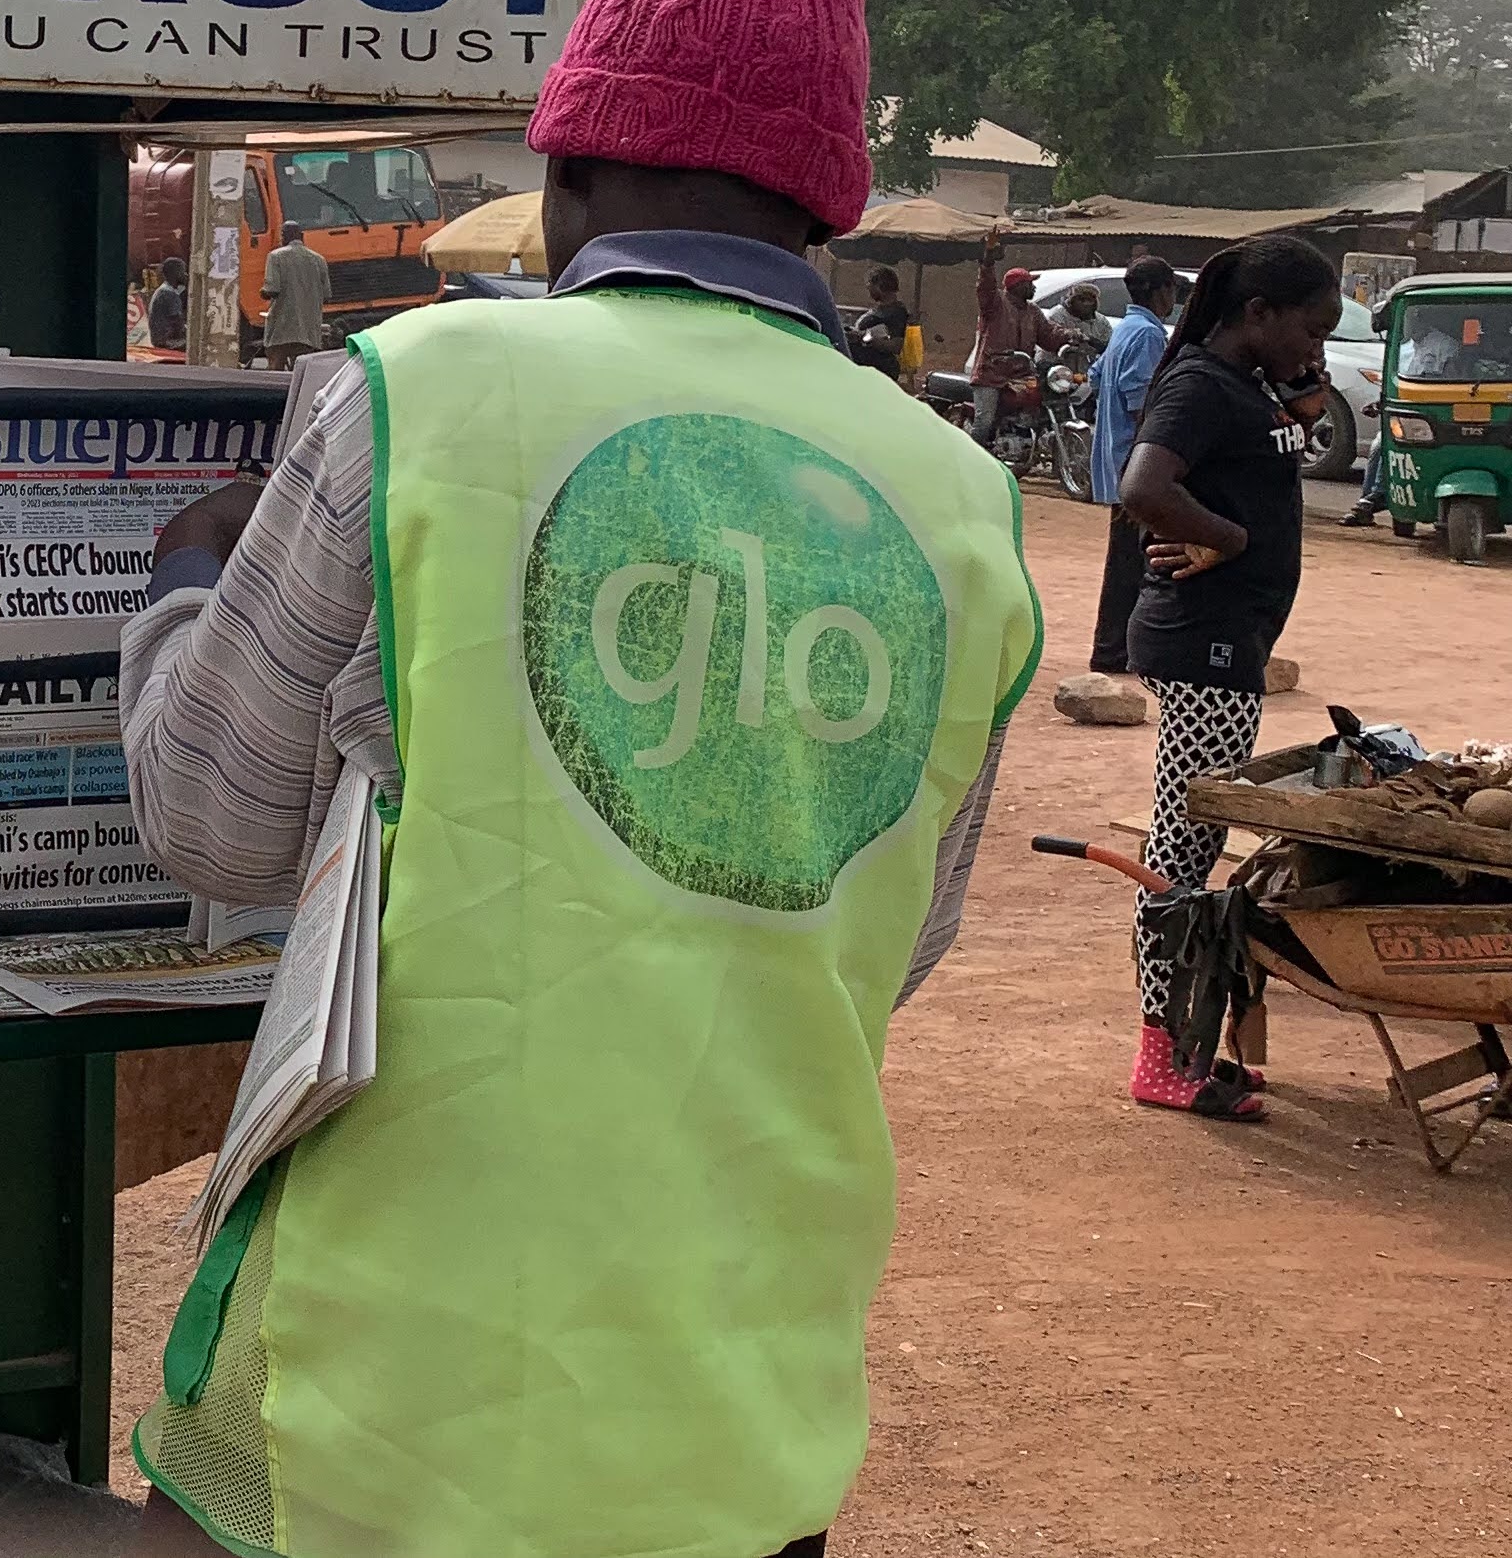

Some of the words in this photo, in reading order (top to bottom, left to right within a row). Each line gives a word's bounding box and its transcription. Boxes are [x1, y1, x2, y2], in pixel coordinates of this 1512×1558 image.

[86, 17, 249, 58] CAN
[285, 23, 549, 64] TRUST
[24, 543, 86, 577] CECPC
[8, 585, 69, 618] starts
[589, 525, 893, 772] glo
[74, 766, 86, 776] as
[89, 763, 126, 777] power
[73, 781, 126, 794] collapses
[33, 829, 89, 856] camp
